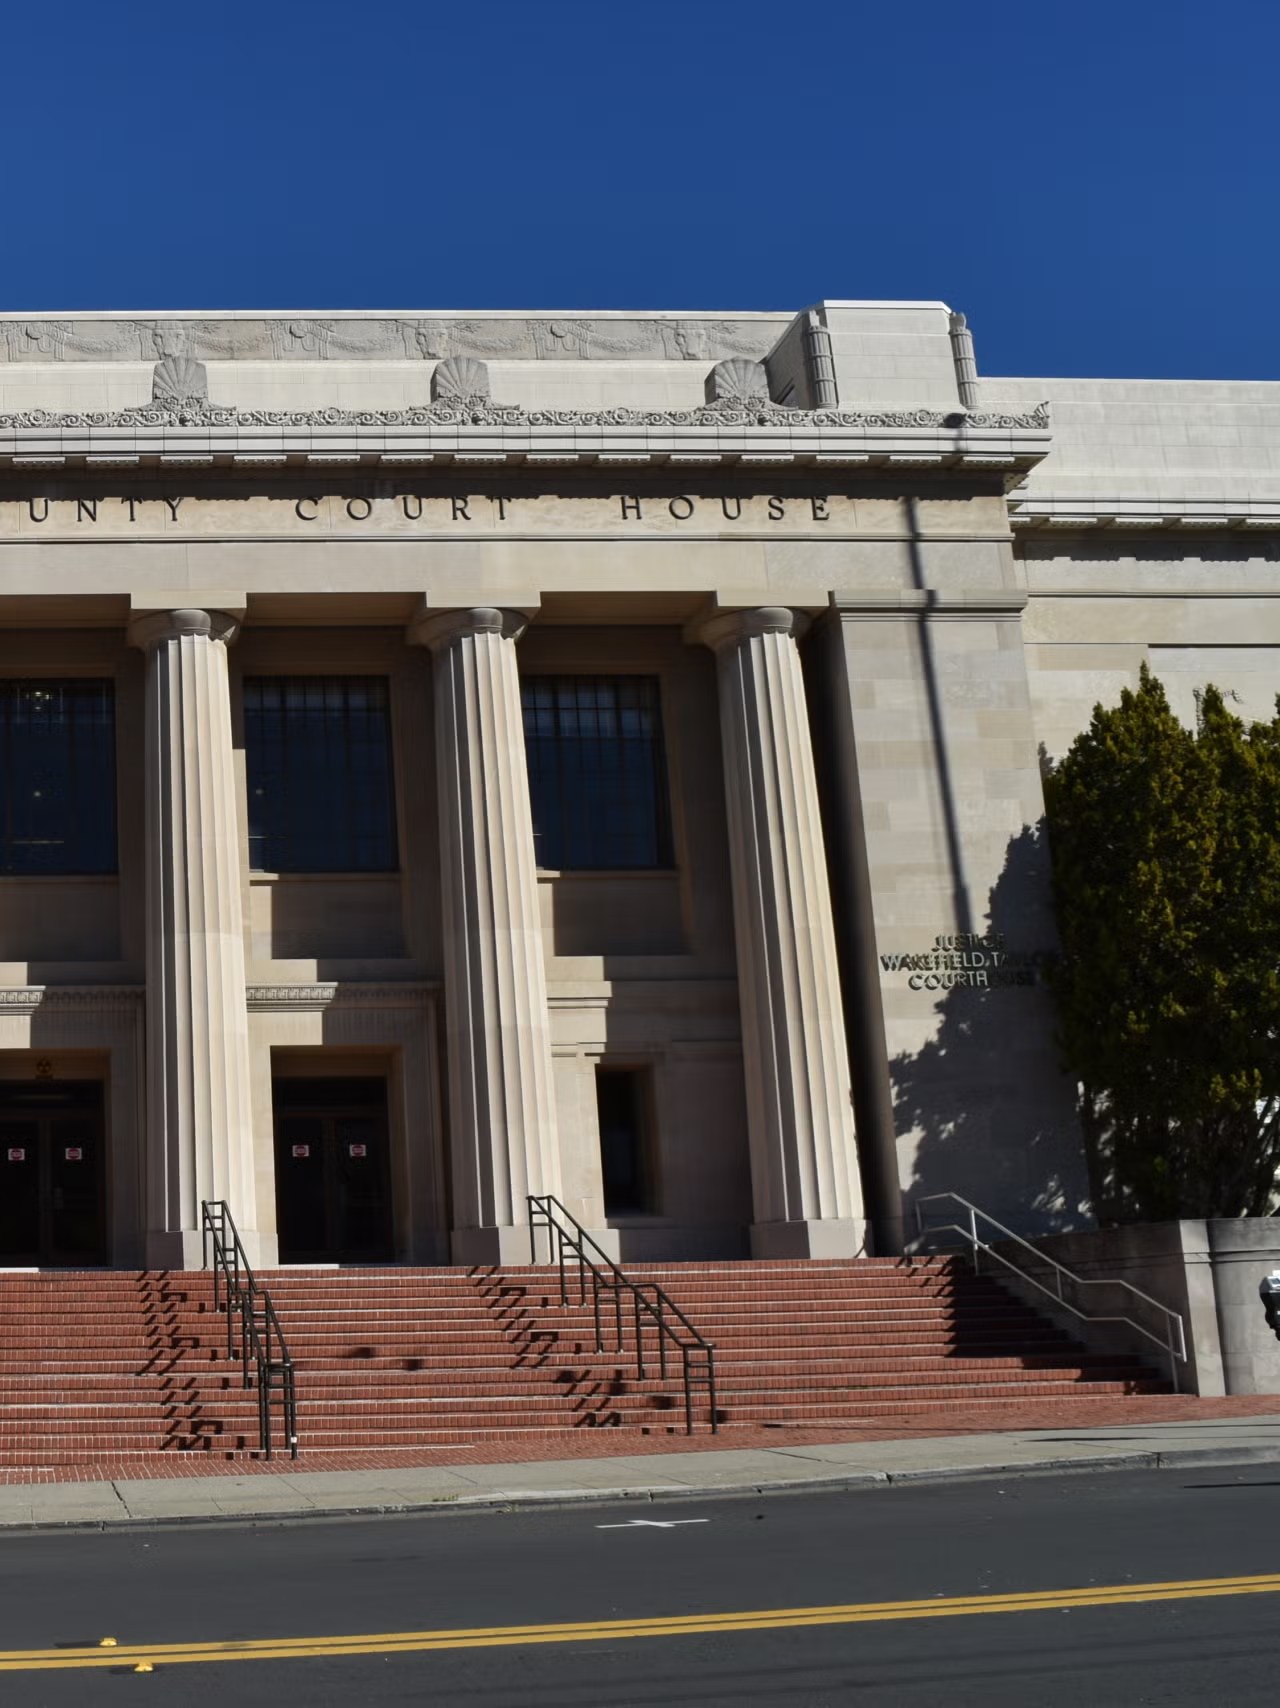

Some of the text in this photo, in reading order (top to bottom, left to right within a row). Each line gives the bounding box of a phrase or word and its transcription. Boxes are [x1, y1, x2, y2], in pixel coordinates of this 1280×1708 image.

[295, 495, 511, 521] COURT
[620, 495, 830, 521] HOUSE
[933, 933, 1005, 951] JUSTICE
[881, 951, 985, 970] WAKEFIELD
